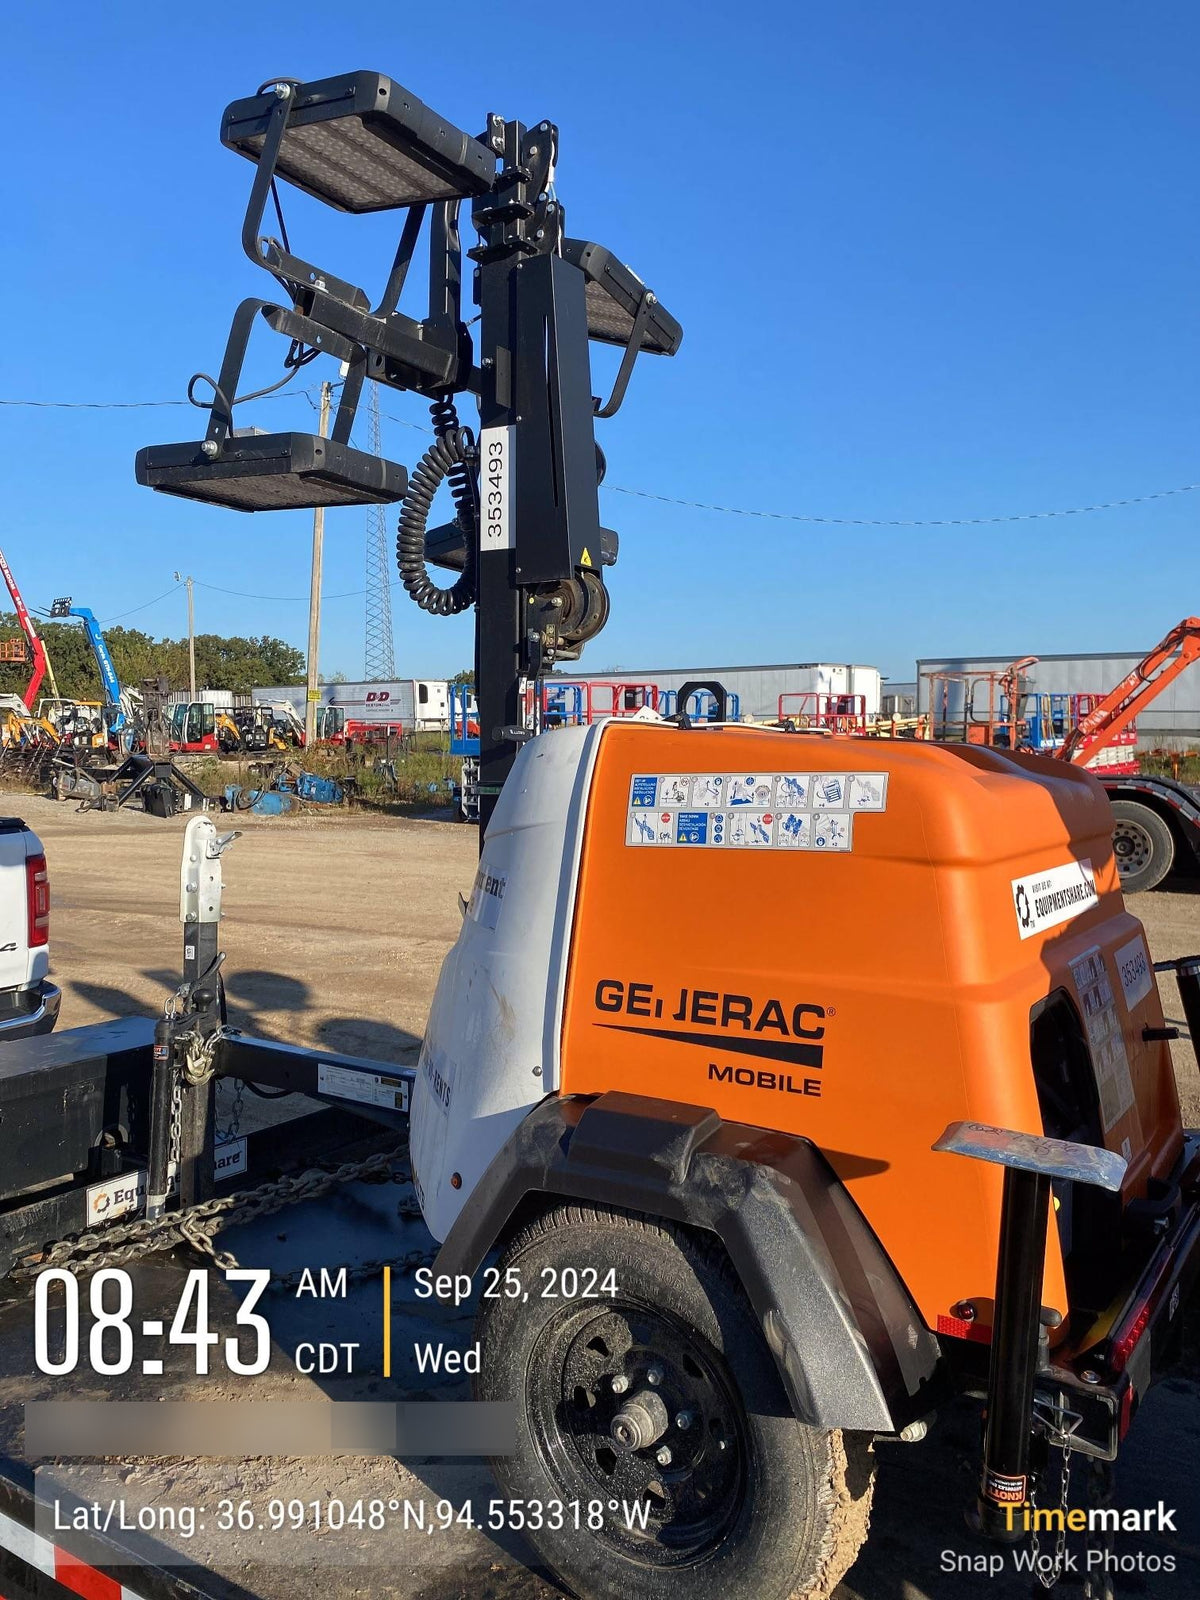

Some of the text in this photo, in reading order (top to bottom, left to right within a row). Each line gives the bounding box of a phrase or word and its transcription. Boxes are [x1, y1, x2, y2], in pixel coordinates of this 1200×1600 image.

[487, 441, 503, 538] 353493
[1034, 879, 1096, 918] EQUIPMENTSHARE.COM
[1121, 951, 1146, 987] 353493
[708, 1063, 822, 1097] MOBILE
